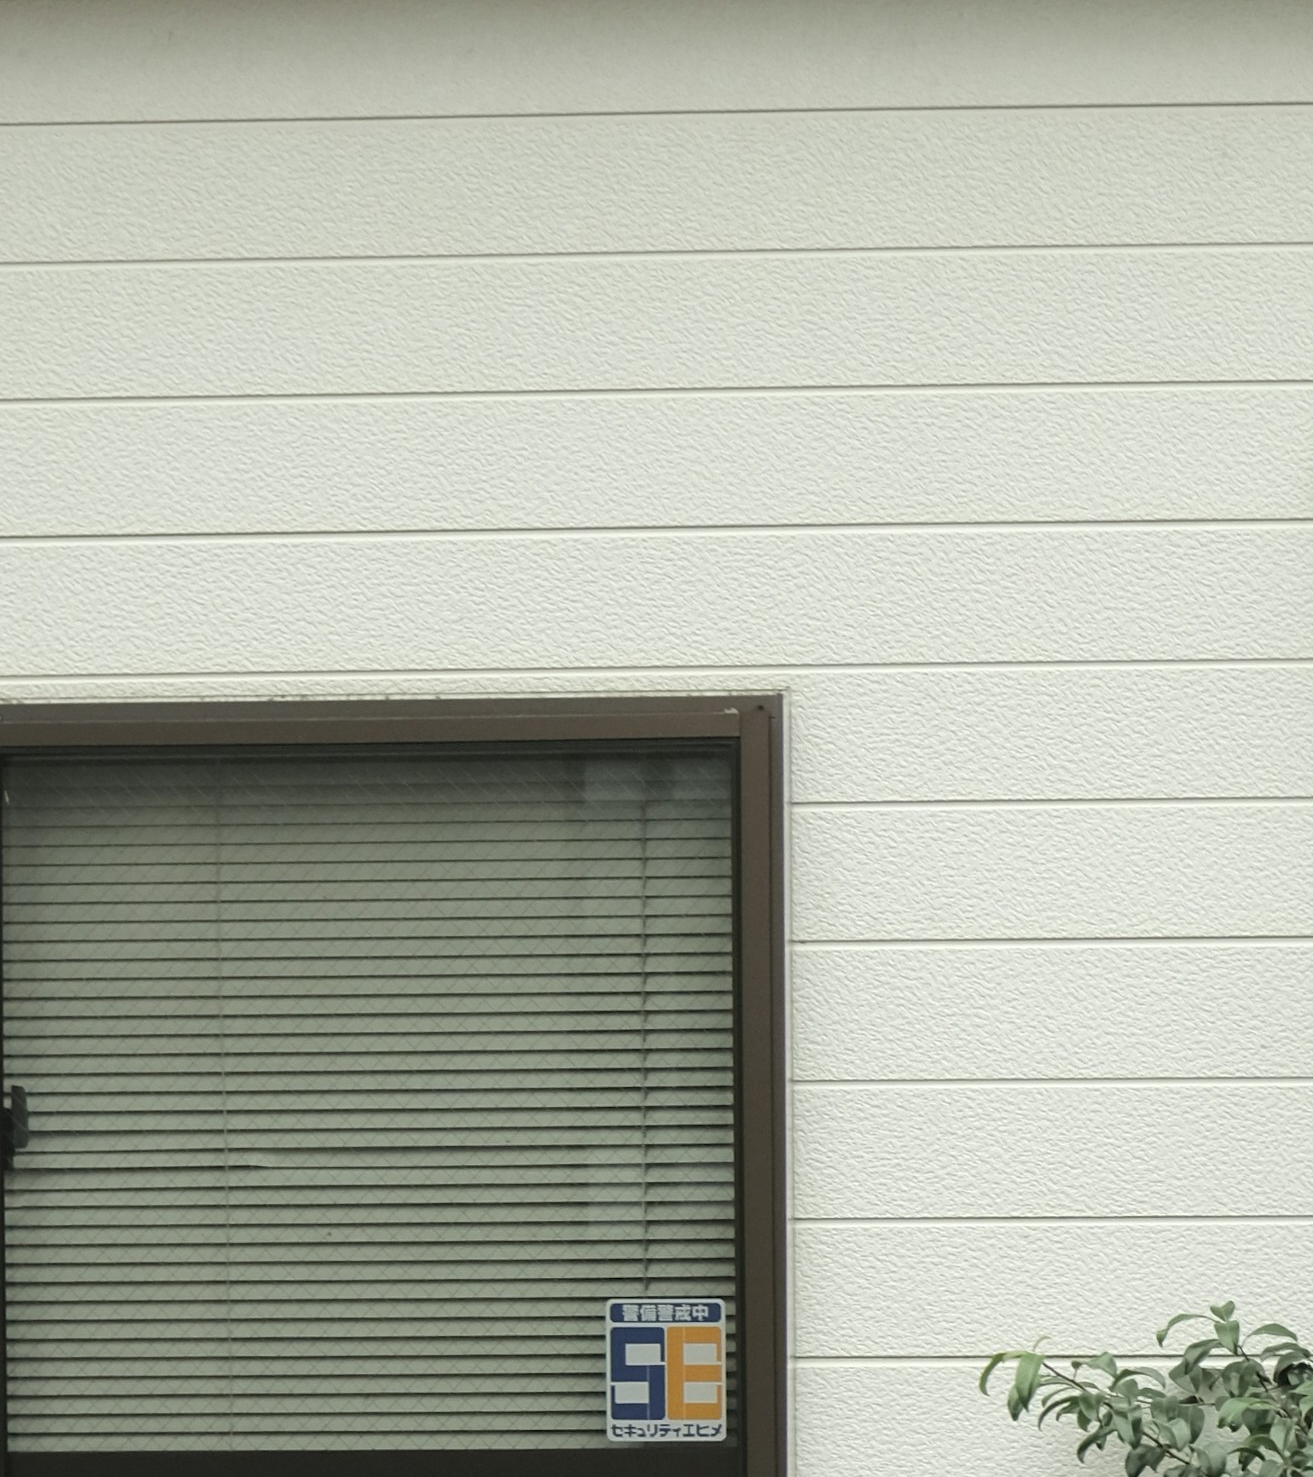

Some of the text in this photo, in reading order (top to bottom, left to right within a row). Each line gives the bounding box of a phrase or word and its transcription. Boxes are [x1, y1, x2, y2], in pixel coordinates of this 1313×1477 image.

[612, 1424, 722, 1437] セキュリティエヒメ
